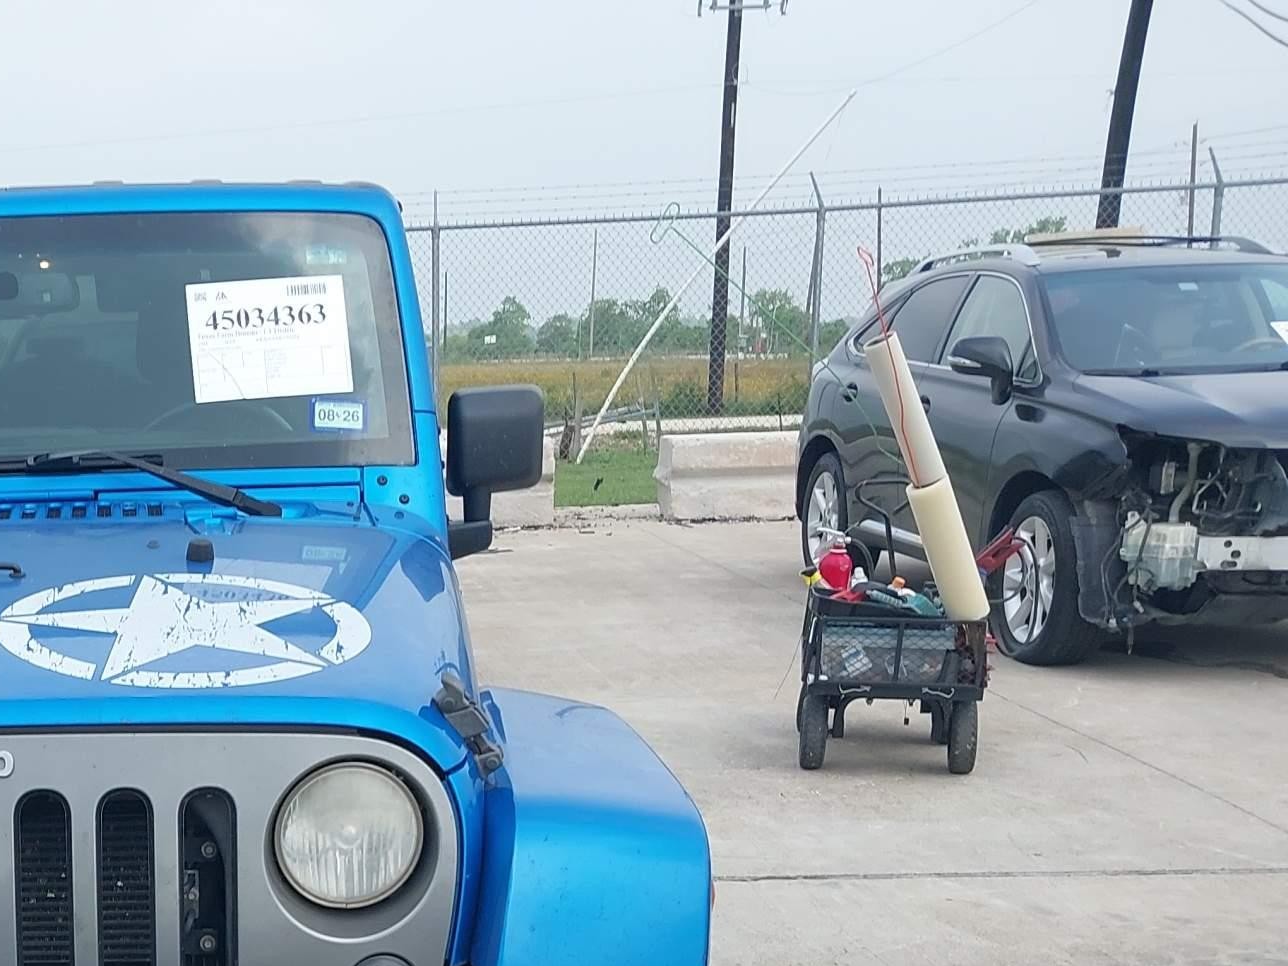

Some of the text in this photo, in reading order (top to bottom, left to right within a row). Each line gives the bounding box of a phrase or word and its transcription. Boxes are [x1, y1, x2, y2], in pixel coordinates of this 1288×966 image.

[205, 303, 327, 331] 45034363
[318, 408, 360, 423] 08 26
